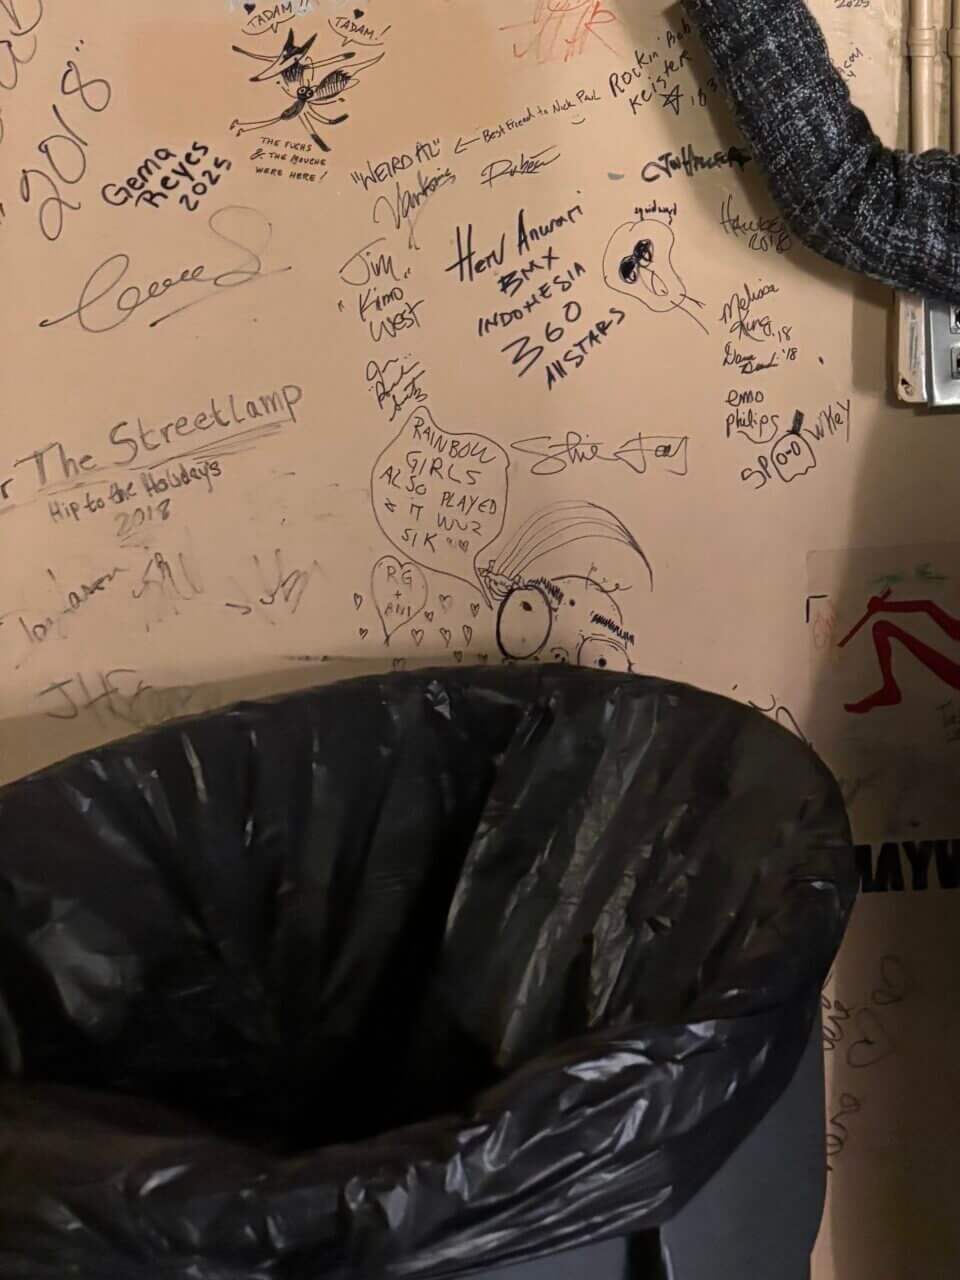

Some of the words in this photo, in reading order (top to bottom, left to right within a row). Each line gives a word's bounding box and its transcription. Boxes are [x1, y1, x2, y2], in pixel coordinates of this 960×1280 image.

[482, 125, 505, 143] Best
[261, 136, 279, 147] THE
[255, 166, 283, 177] WERE
[406, 450, 481, 485] GIRLS
